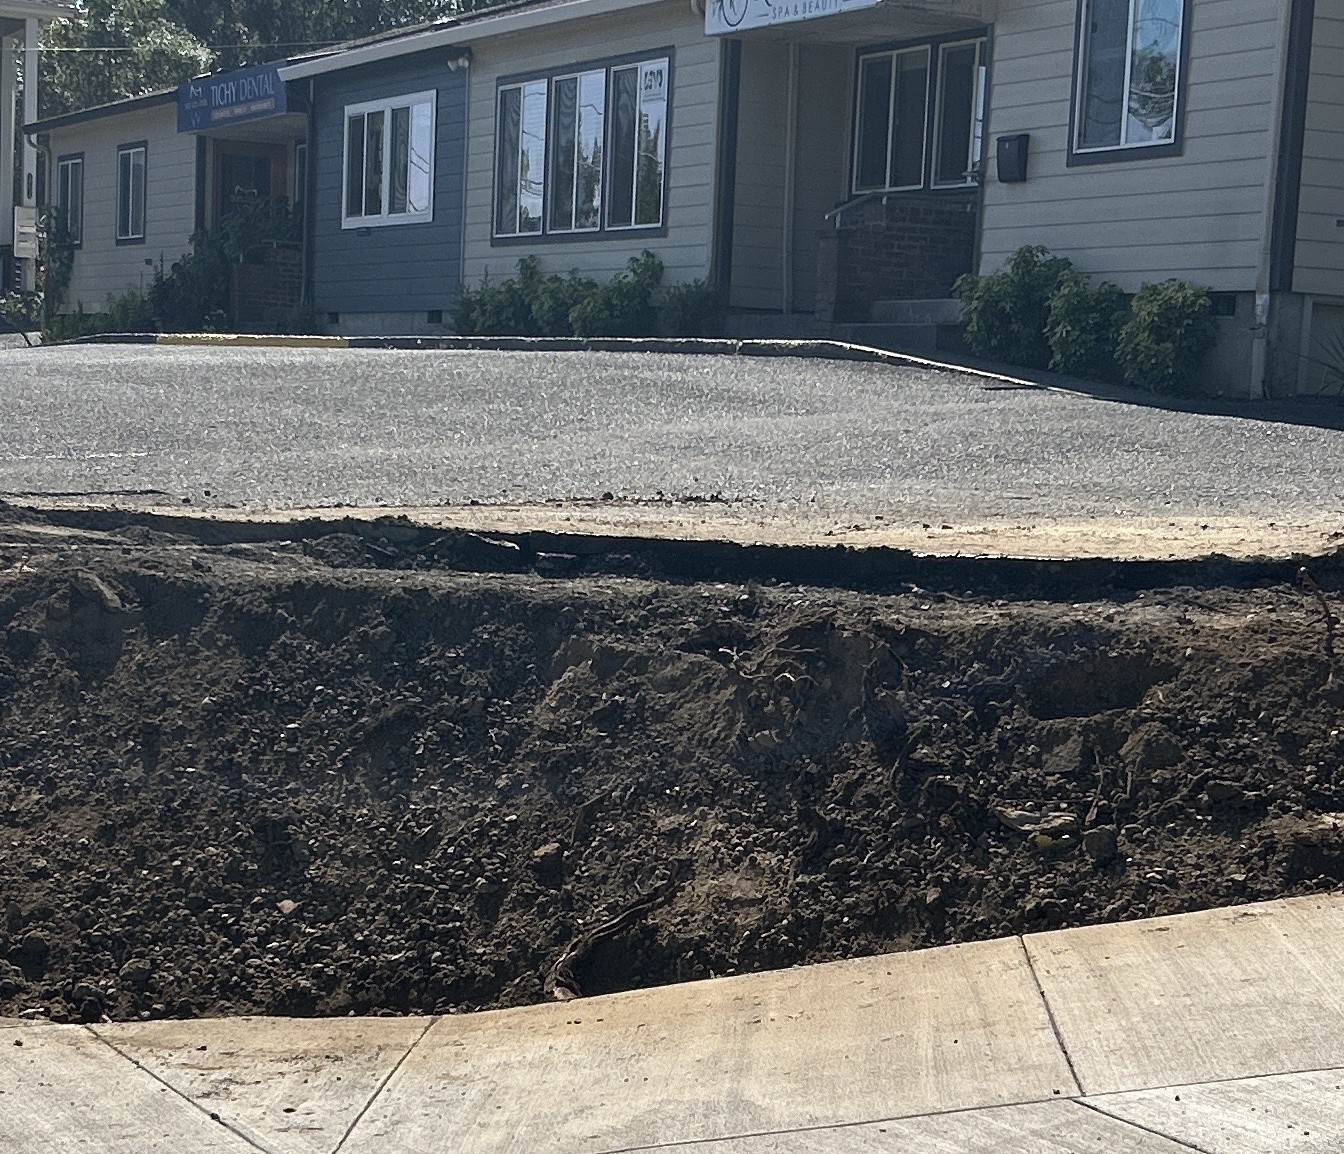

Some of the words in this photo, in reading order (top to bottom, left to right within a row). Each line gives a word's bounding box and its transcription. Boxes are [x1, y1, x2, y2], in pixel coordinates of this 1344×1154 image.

[772, 7, 790, 19] SPA
[210, 80, 238, 107] TICHY
[239, 73, 275, 102] DENTAL
